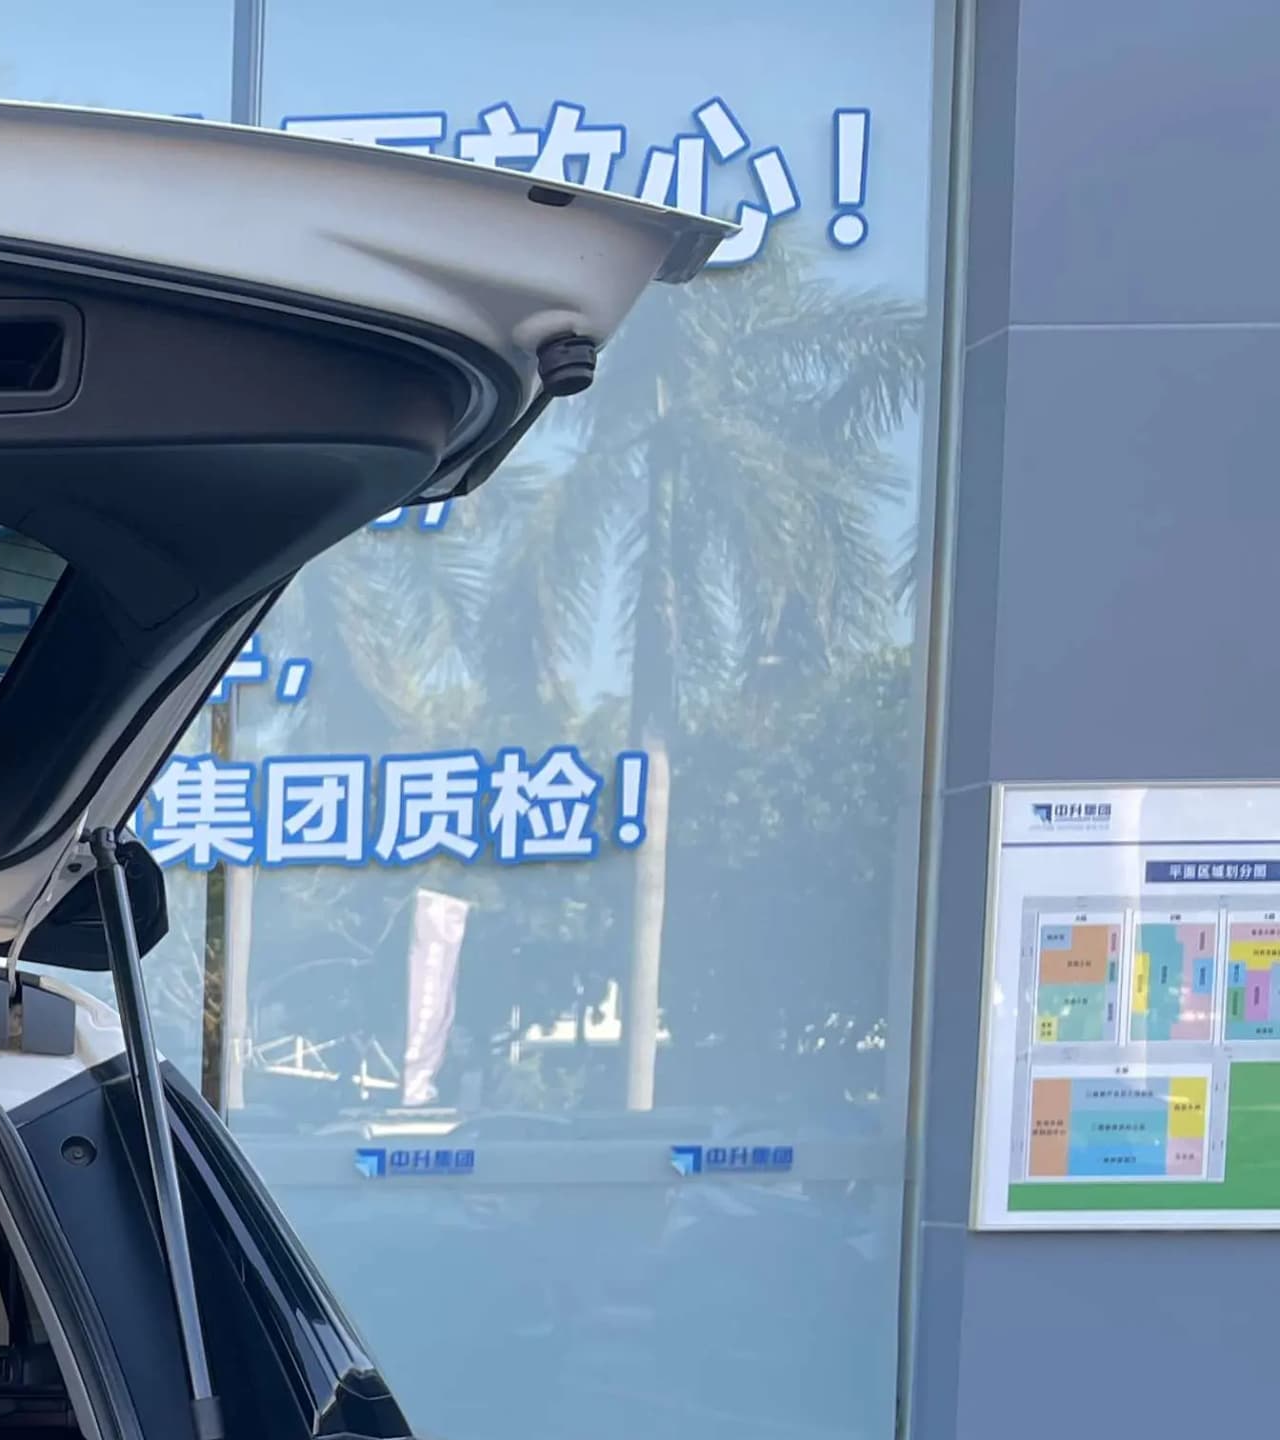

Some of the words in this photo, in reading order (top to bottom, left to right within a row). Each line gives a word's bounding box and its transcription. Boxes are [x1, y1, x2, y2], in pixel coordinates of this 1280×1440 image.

[282, 95, 870, 268] 放心！
[390, 1149, 475, 1168] 中升集团
[705, 1146, 793, 1166] 中升集团
